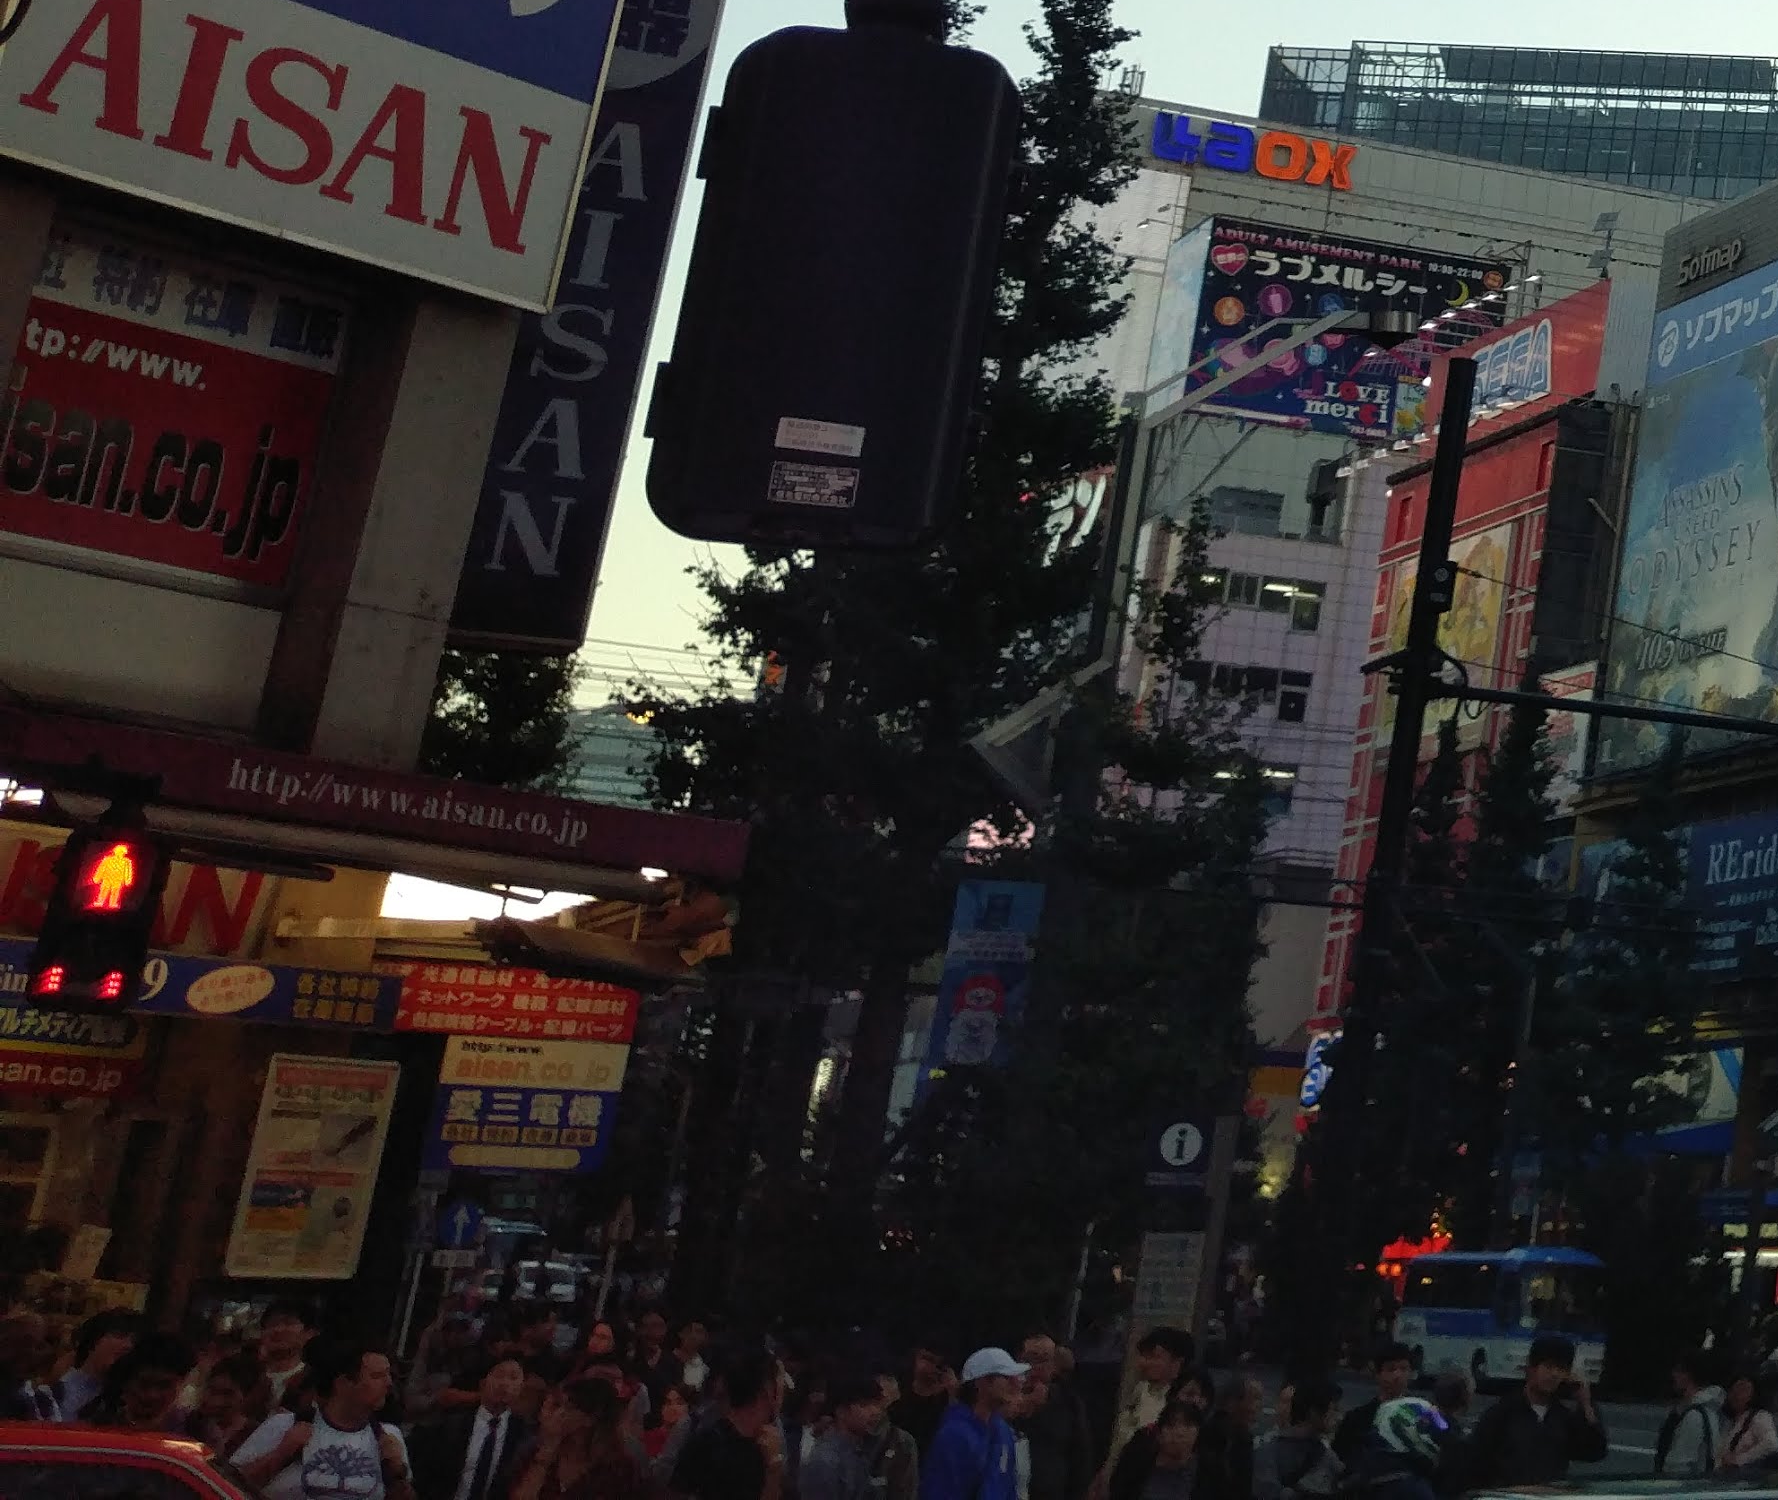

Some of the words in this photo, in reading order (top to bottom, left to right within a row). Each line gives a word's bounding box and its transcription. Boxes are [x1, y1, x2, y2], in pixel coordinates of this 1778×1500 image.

[1249, 249, 1428, 297] ラブメルシー
[1379, 252, 1423, 271] PARK
[1676, 236, 1743, 287] Sofmap
[485, 120, 648, 578] AISAN
[1629, 520, 1761, 596] ODYSSEY
[228, 758, 590, 846] http://www.aisan.co.jp
